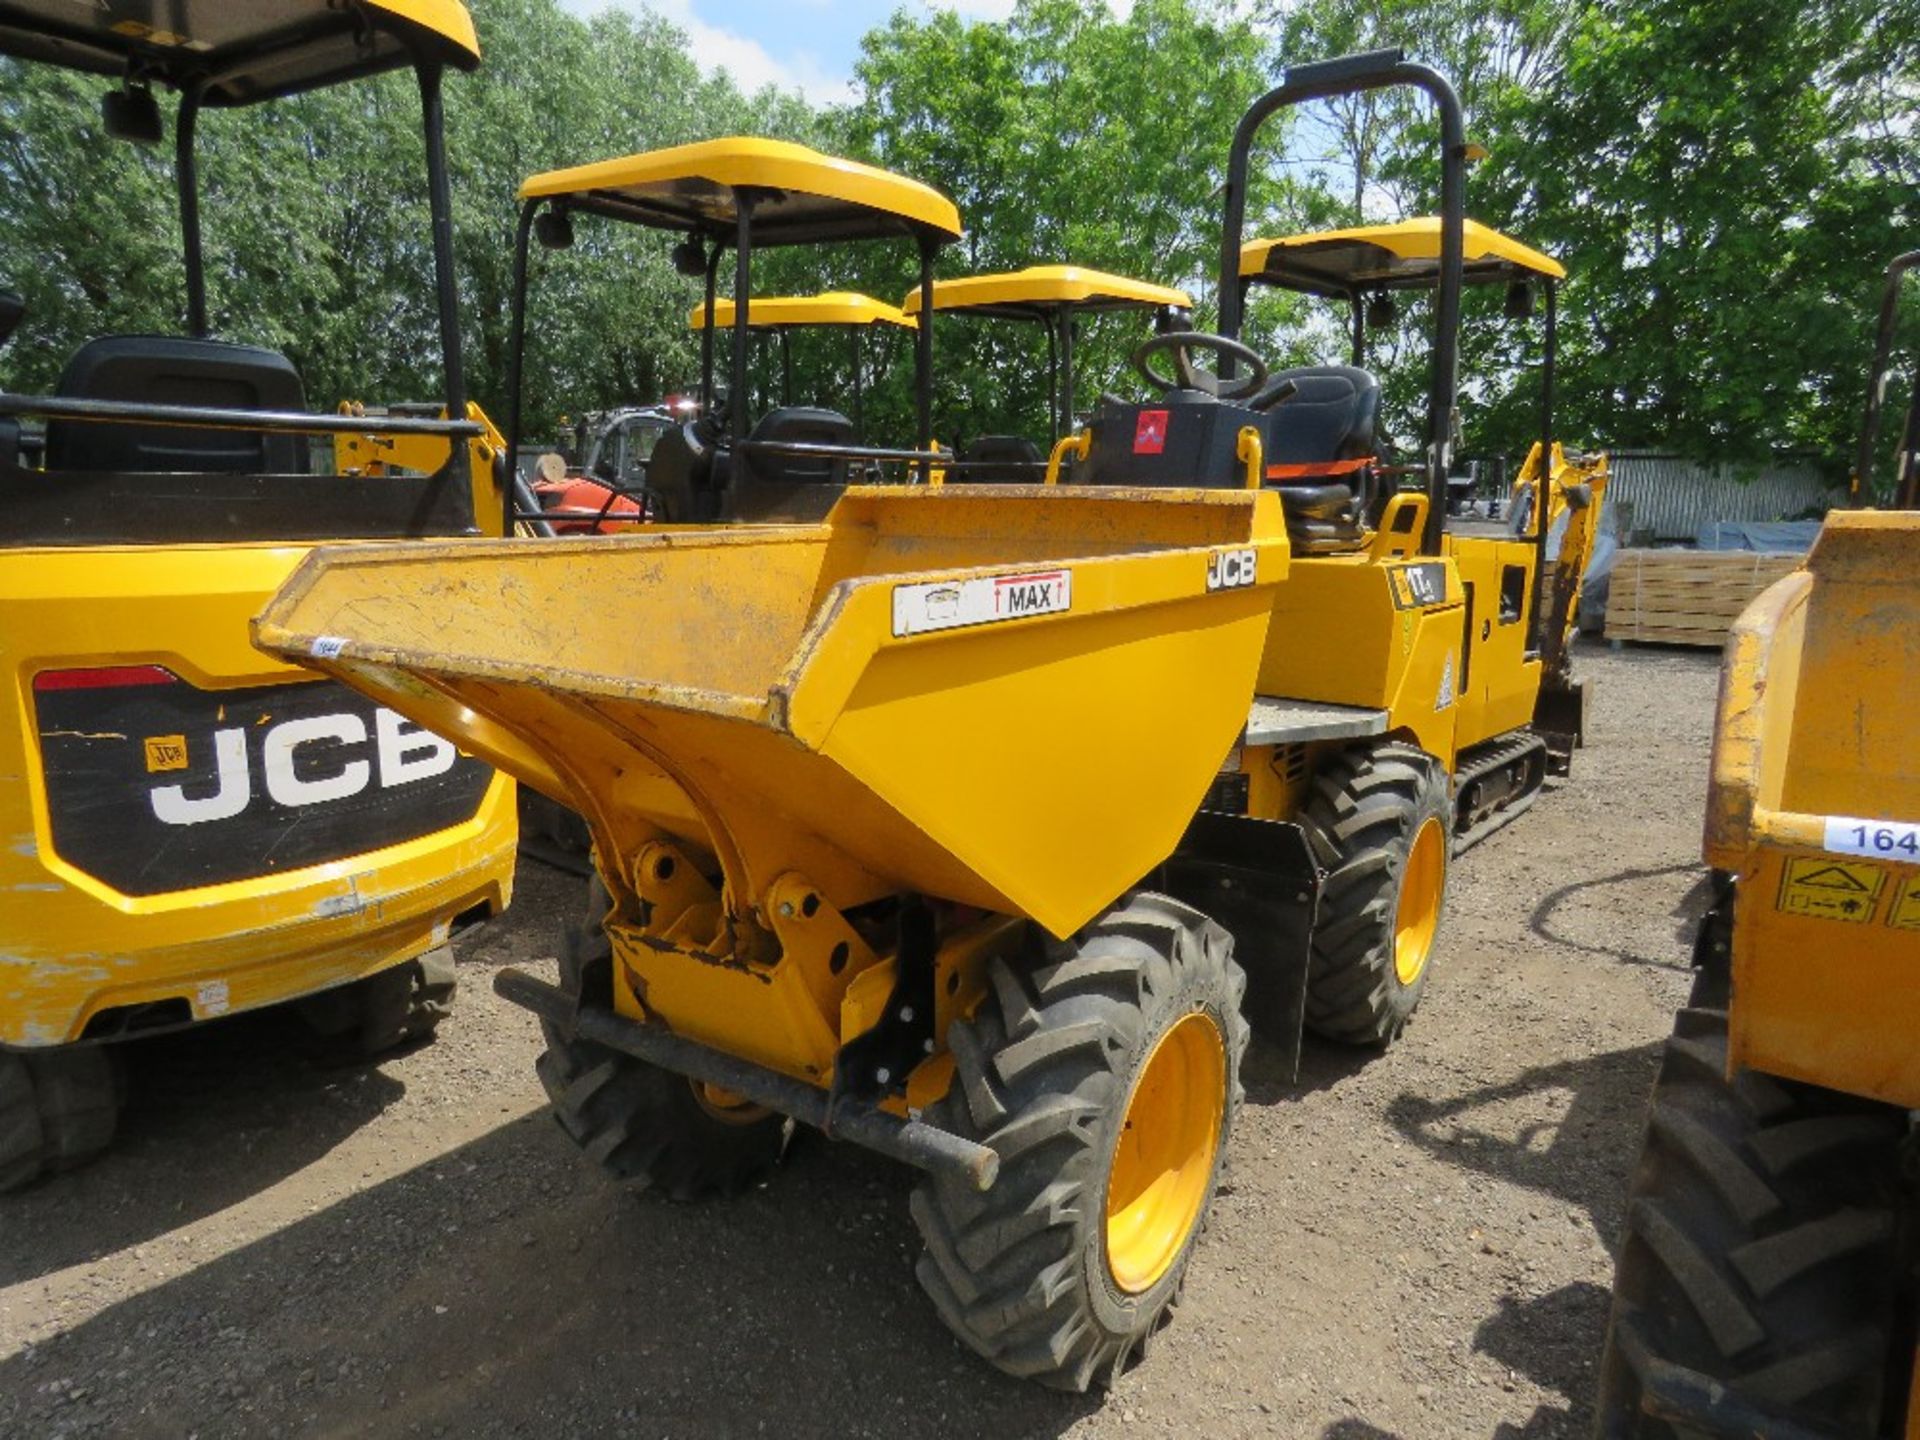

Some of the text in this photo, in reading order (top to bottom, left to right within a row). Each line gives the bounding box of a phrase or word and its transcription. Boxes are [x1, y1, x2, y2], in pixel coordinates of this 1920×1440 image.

[1207, 550, 1255, 589] JCB
[1009, 583, 1051, 612] MAX
[150, 707, 456, 826] JCB
[155, 745, 182, 766] JCB
